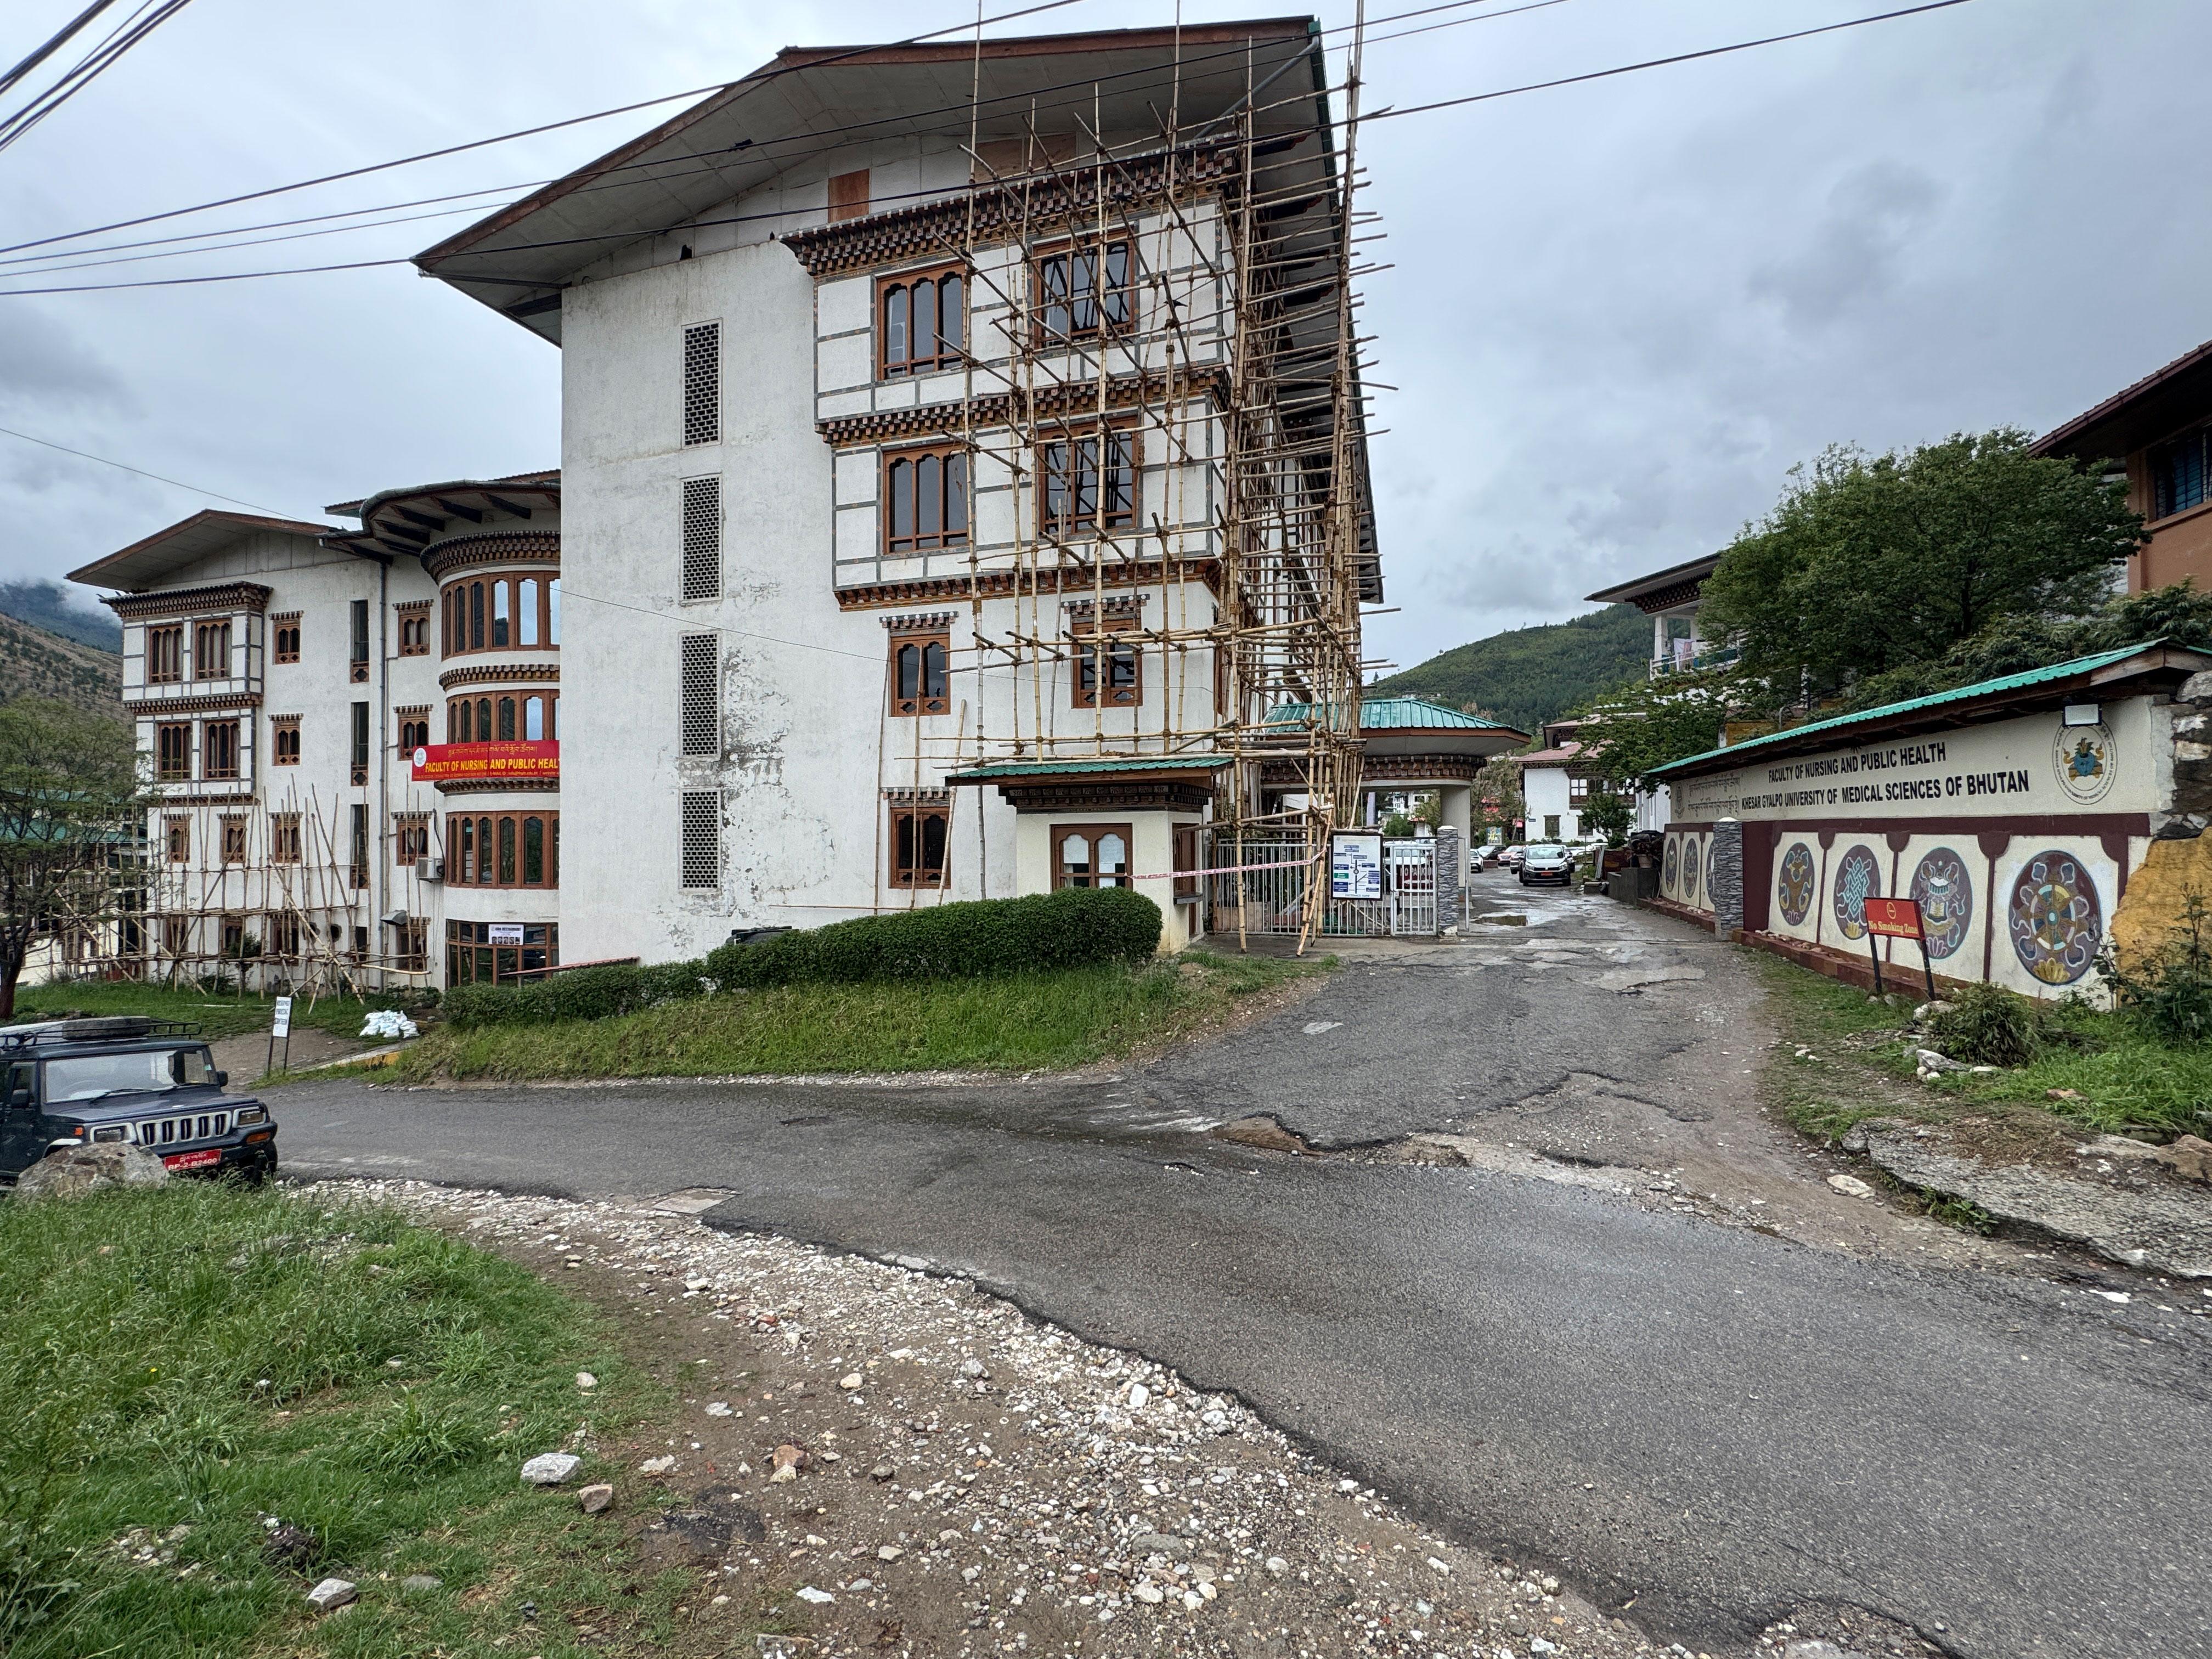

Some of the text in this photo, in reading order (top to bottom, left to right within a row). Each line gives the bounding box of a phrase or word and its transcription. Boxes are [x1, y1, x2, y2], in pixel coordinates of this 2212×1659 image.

[425, 758, 560, 773] FACULTY OF NURSING AND PUBLIC HEAL
[1768, 742, 1946, 783] FACULTY OF NURSING AND PUBLIC HEALTH
[1742, 795, 1762, 810] KHESAR
[1762, 793, 1782, 809] GYALPO
[1785, 789, 1825, 808] UNIVERSITY
[1827, 788, 1837, 804] OF
[1842, 784, 1883, 804] MEDICAL
[1885, 778, 1941, 801] SCIENCES
[1945, 776, 1962, 797] OF
[1967, 770, 2029, 795] BHUTAN
[1868, 921, 1877, 930] No
[1878, 921, 1904, 935] Smoking
